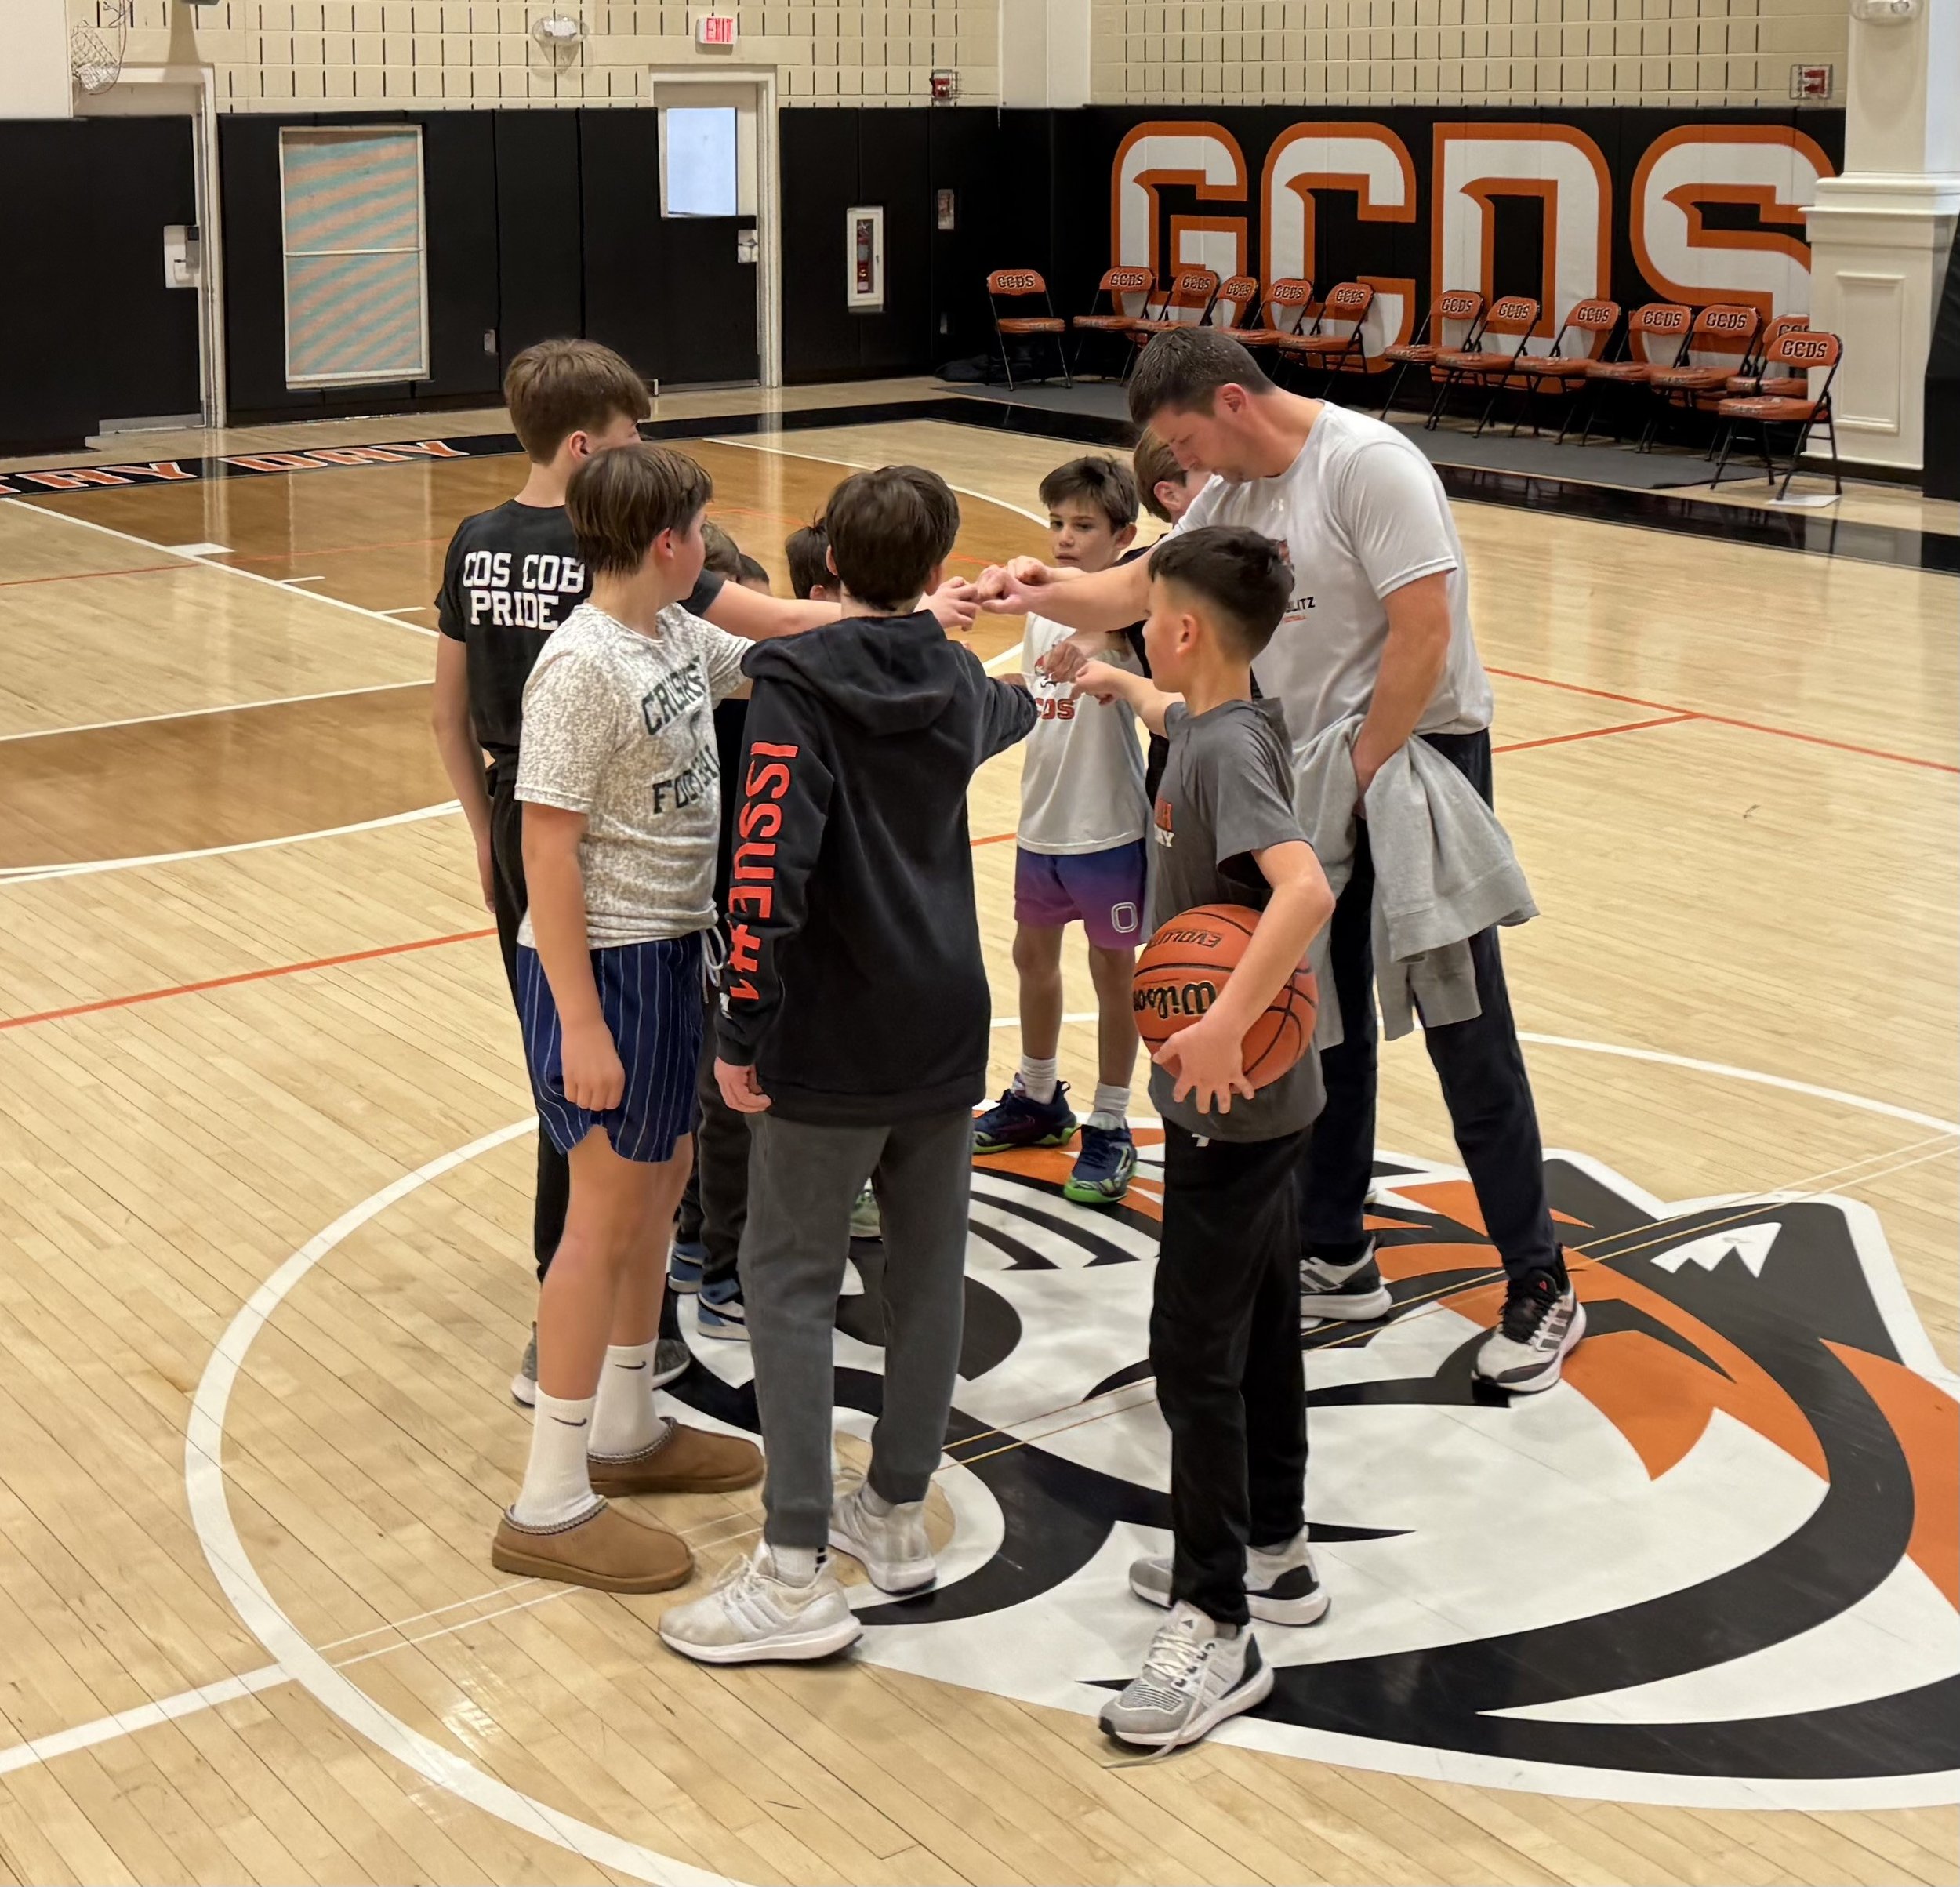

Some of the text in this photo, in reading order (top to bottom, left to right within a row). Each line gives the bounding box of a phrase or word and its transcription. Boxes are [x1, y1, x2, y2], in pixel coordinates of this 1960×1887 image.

[706, 17, 734, 42] EXIT
[1111, 121, 1837, 404] GCDS
[1642, 310, 1682, 328] GCDS
[1706, 311, 1748, 330] GCDS
[1781, 339, 1828, 358] GCDS
[218, 439, 470, 473] DAY
[463, 550, 586, 593] COS COB
[470, 590, 560, 630] PRIDE
